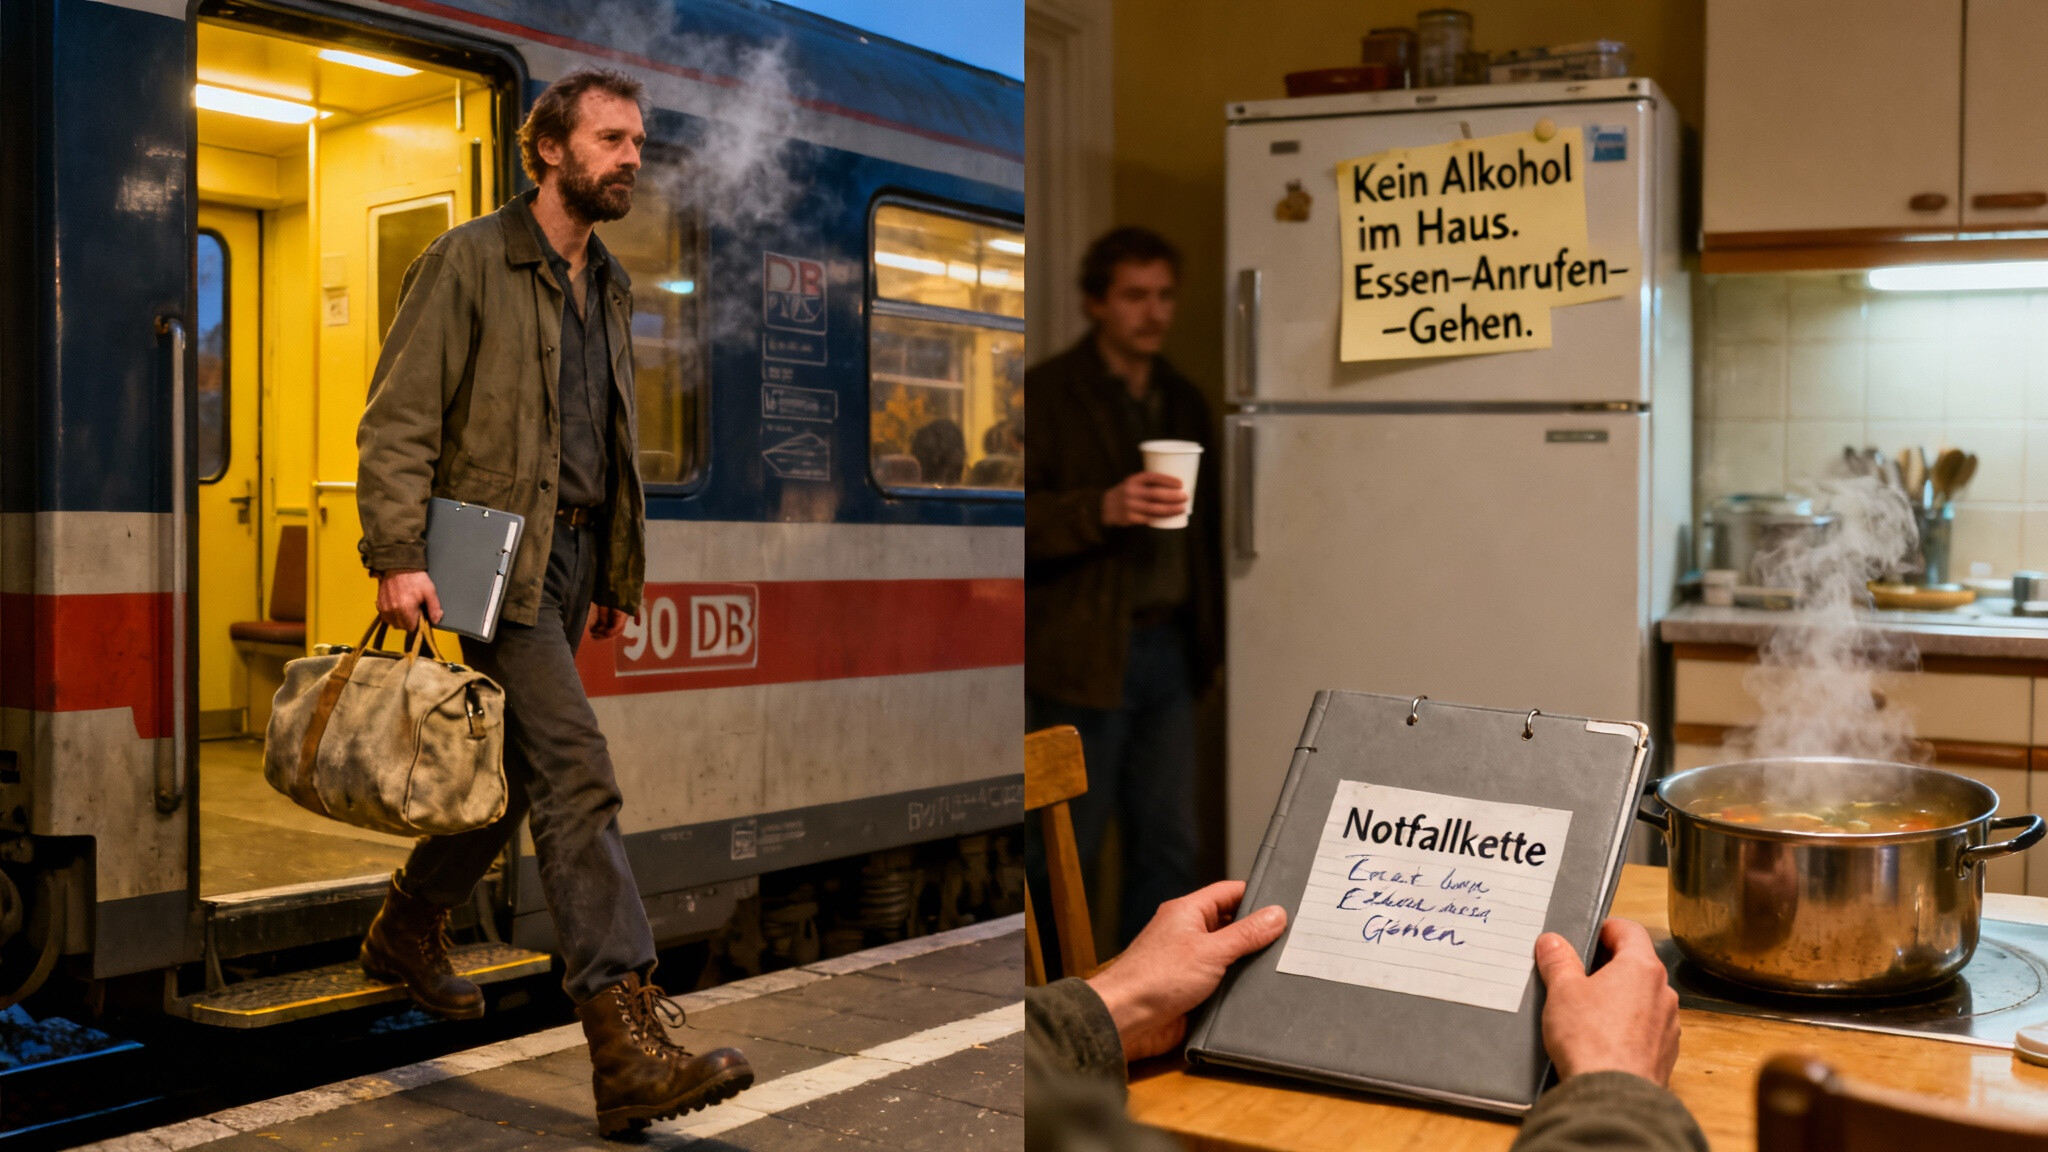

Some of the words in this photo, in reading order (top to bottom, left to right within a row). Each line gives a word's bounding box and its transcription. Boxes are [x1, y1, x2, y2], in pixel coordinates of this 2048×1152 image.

[1353, 163, 1428, 203] Kein
[1440, 143, 1572, 195] Alkohol
[1358, 215, 1400, 252] im
[1417, 207, 1519, 246] Haus.
[692, 597, 751, 657] DB
[1342, 806, 1547, 866] Notfallkette
